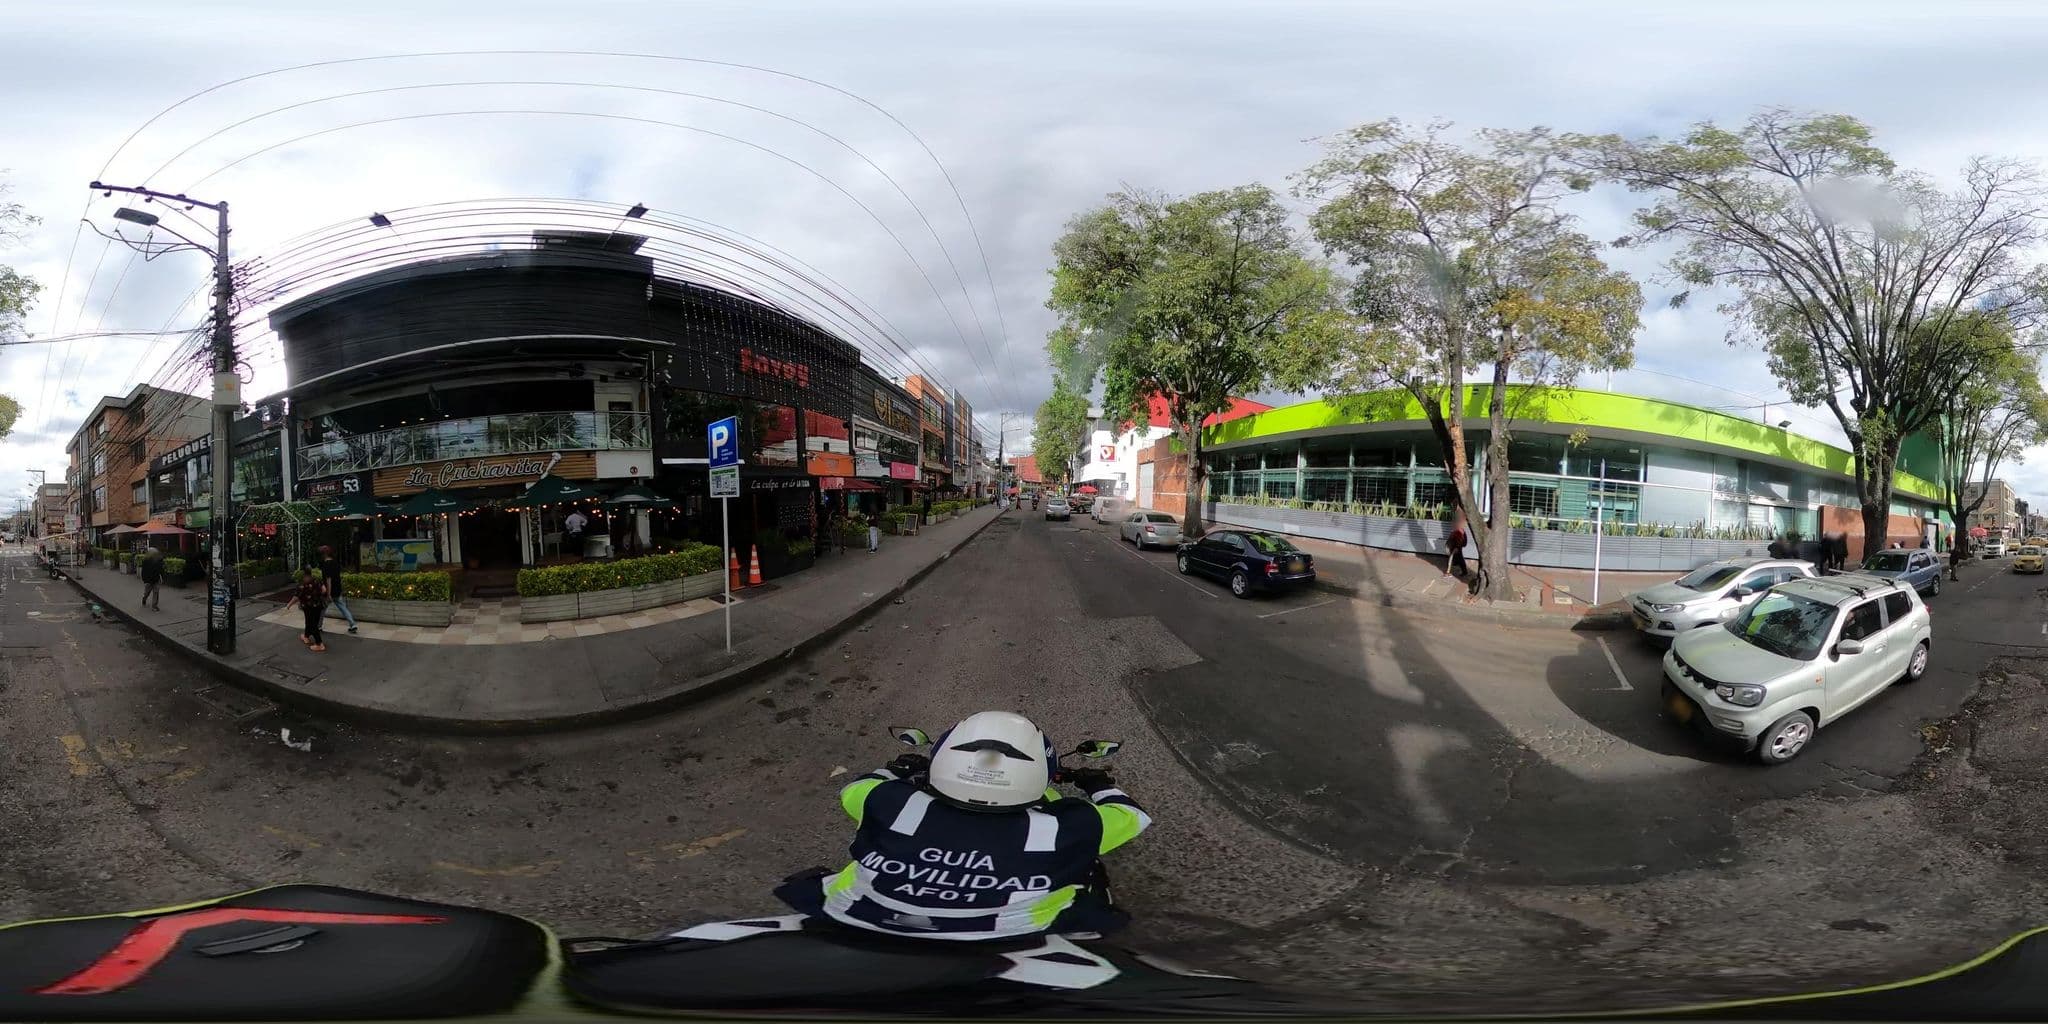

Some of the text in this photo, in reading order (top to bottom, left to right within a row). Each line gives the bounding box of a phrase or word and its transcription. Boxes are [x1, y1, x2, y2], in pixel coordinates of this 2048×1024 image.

[711, 425, 729, 460] P
[404, 458, 544, 488] La Cucharita
[343, 478, 359, 493] 53
[762, 479, 779, 491] culpa
[861, 851, 1052, 891] MOVILIDAD
[919, 848, 995, 871] GUÍA
[894, 883, 978, 902] AF01
